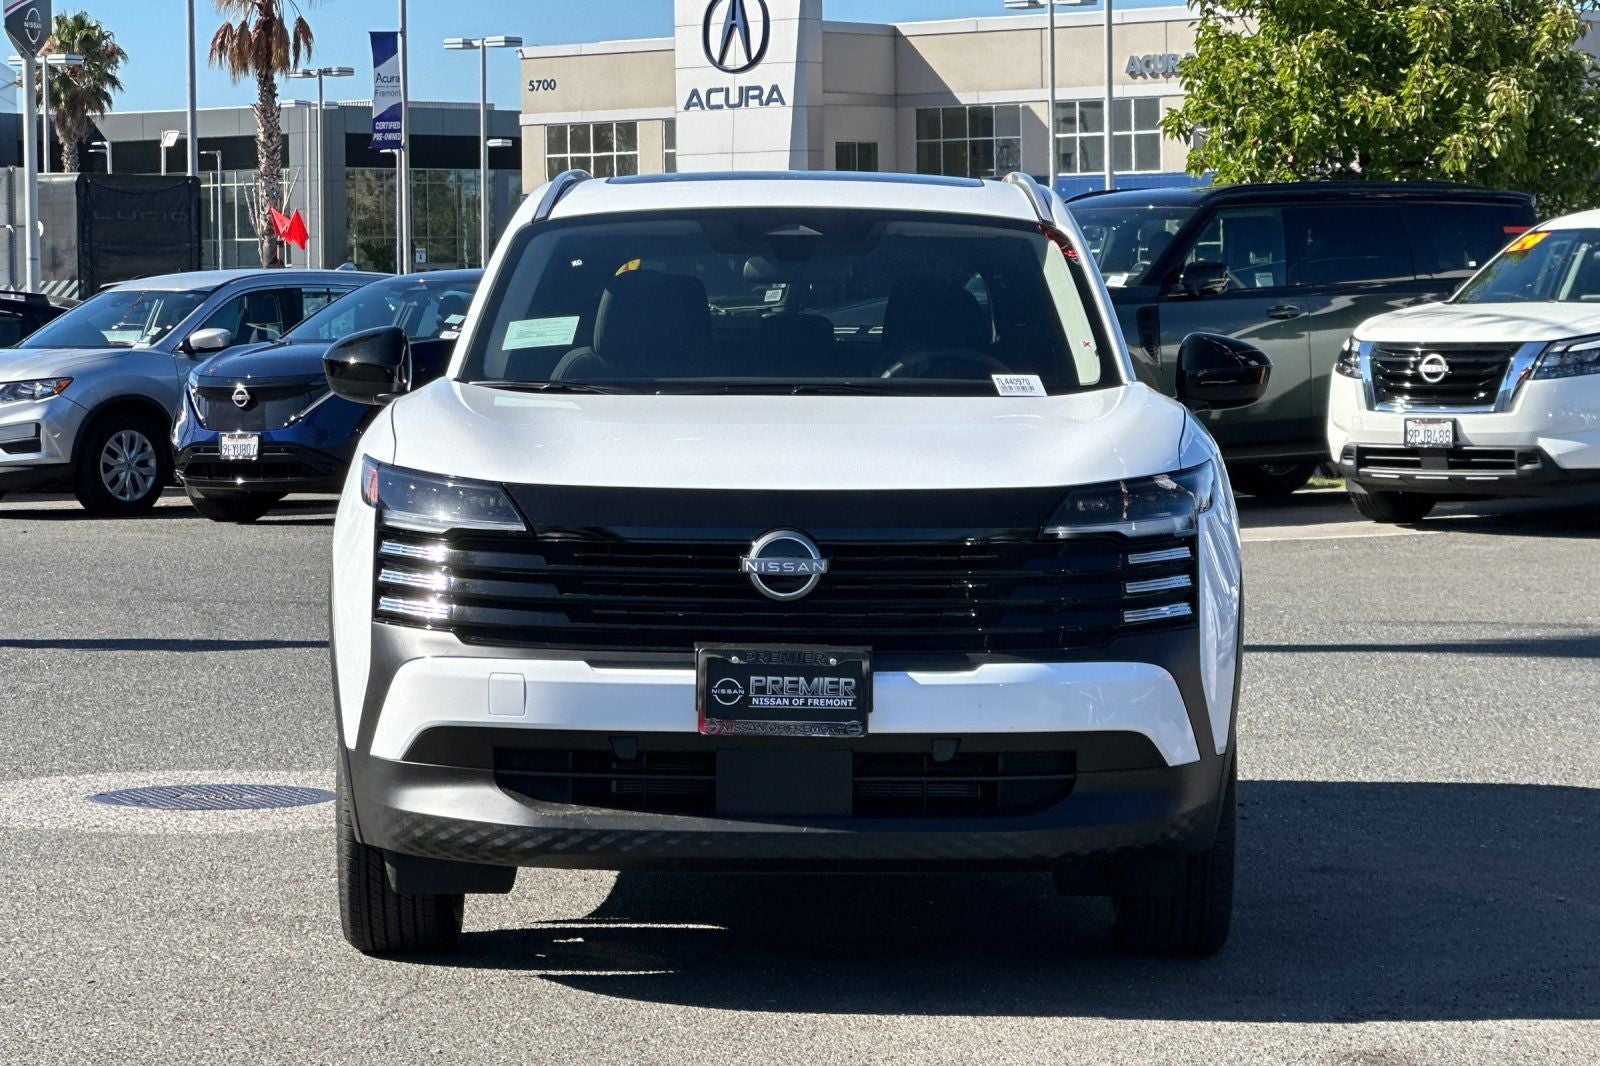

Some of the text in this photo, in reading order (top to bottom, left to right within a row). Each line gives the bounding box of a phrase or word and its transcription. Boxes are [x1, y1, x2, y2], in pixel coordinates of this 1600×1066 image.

[24, 21, 41, 29] NISSAN
[375, 72, 400, 84] Acura
[528, 78, 557, 92] 5700
[375, 89, 401, 97] Fremont
[683, 83, 786, 111] ACURA
[375, 121, 401, 130] CERTIFIED
[373, 132, 401, 141] PRE-OWNED
[745, 561, 825, 572] NISSAN
[744, 651, 825, 665] PREMIER
[750, 676, 857, 697] PREMIER
[752, 697, 854, 706] NISSAN OF FREMONT
[721, 722, 846, 735] NISSAN OF FREMONT
